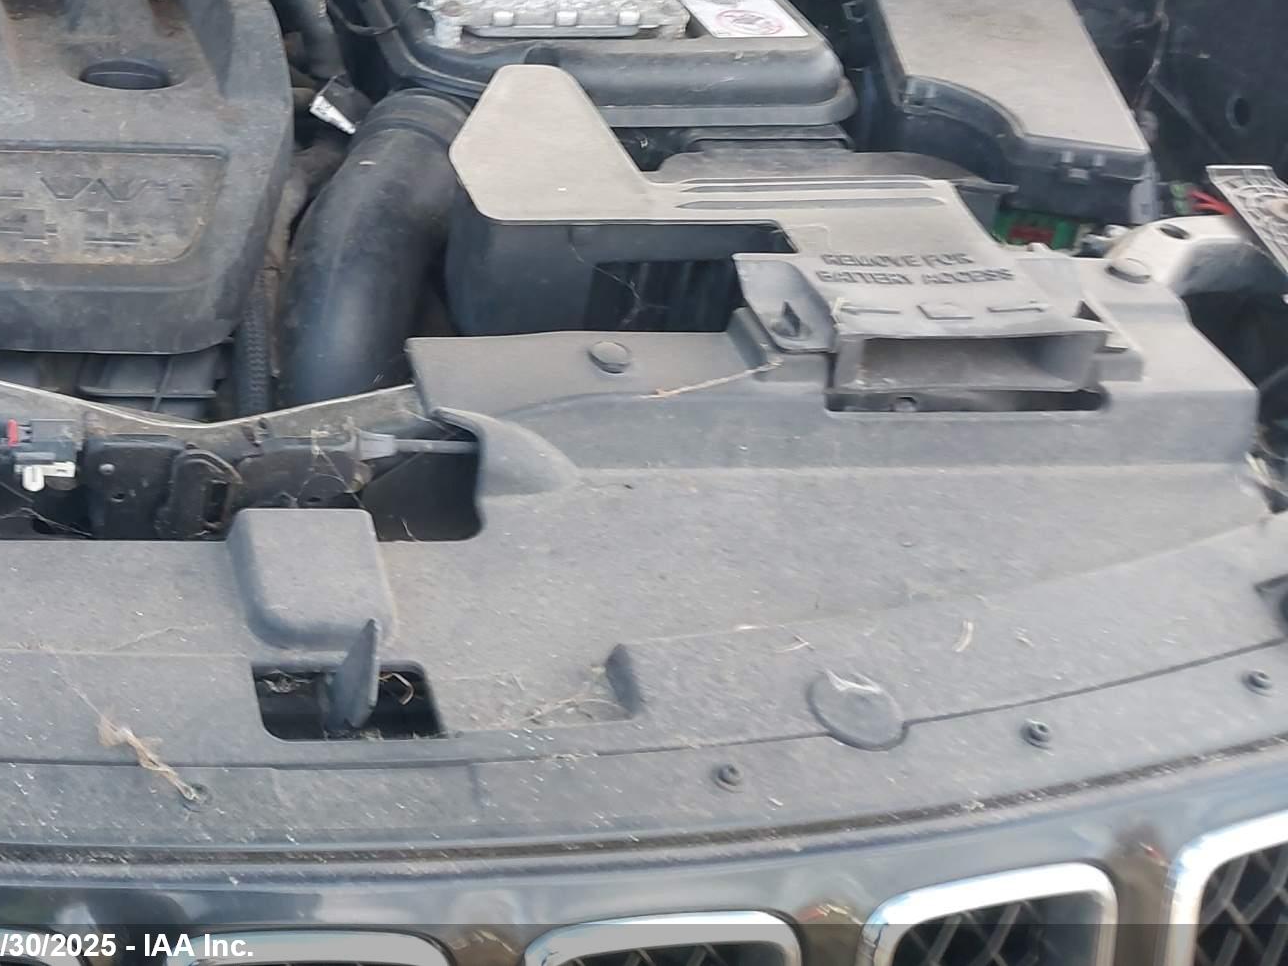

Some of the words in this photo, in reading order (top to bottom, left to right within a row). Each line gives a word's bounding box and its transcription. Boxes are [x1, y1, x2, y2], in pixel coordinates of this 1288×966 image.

[821, 254, 921, 267] REMOVE
[922, 253, 975, 268] FOR
[815, 270, 913, 284] BATTERY
[921, 268, 1014, 284] ACCESS
